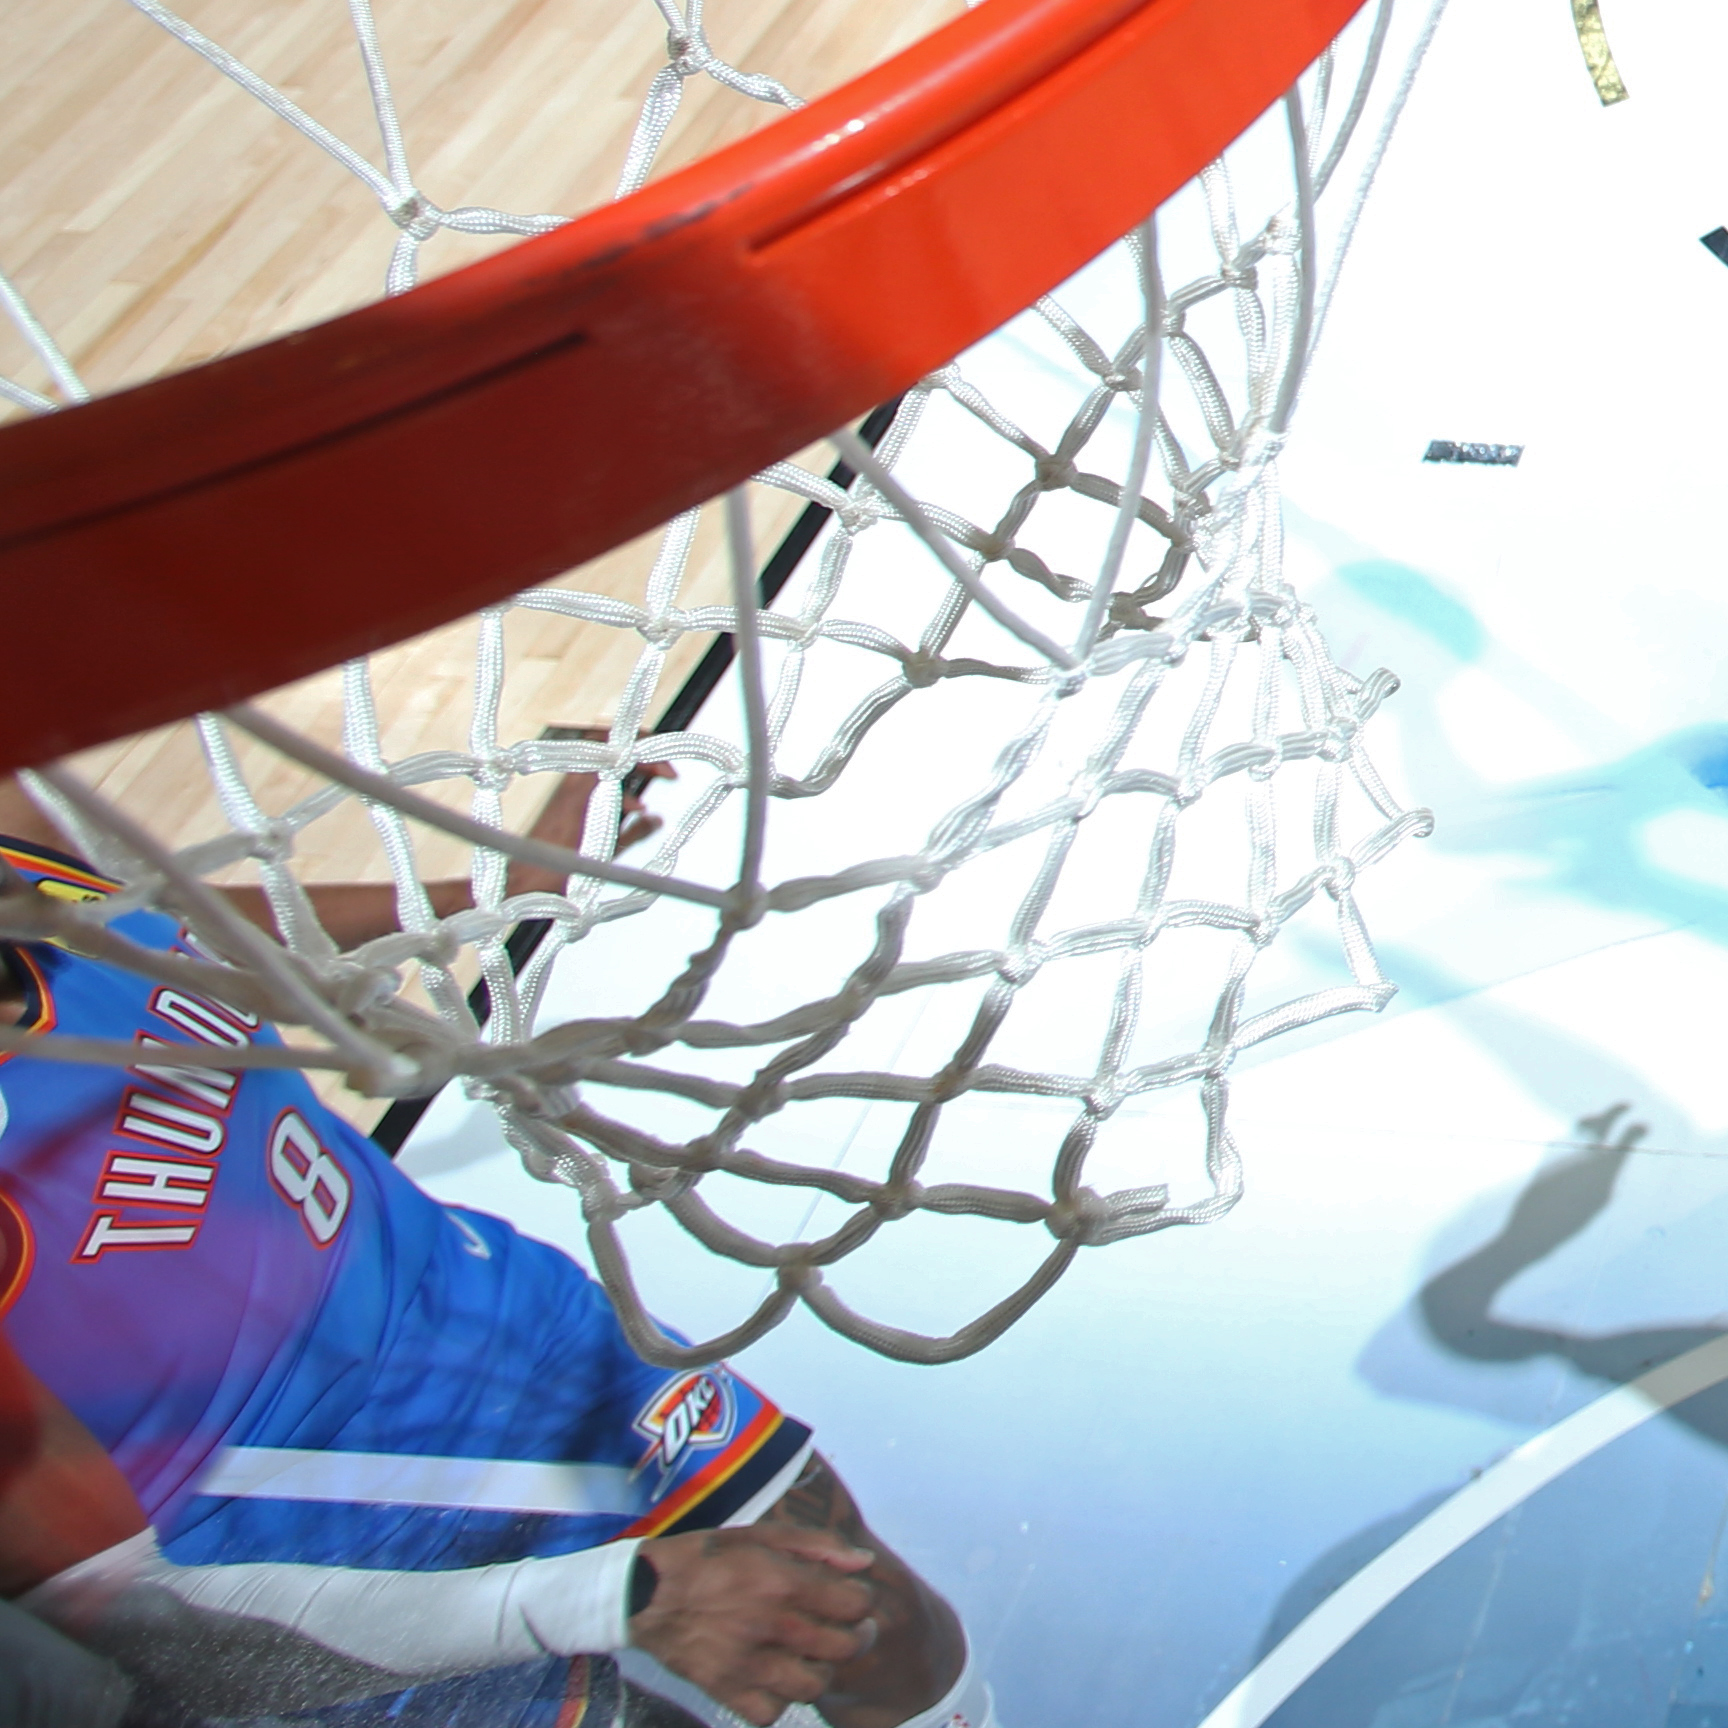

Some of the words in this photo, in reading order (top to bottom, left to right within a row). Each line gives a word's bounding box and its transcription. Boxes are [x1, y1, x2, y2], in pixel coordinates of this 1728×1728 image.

[70, 924, 262, 1264] THUND
[267, 1106, 352, 1250] 8
[662, 1374, 717, 1465] OKC
